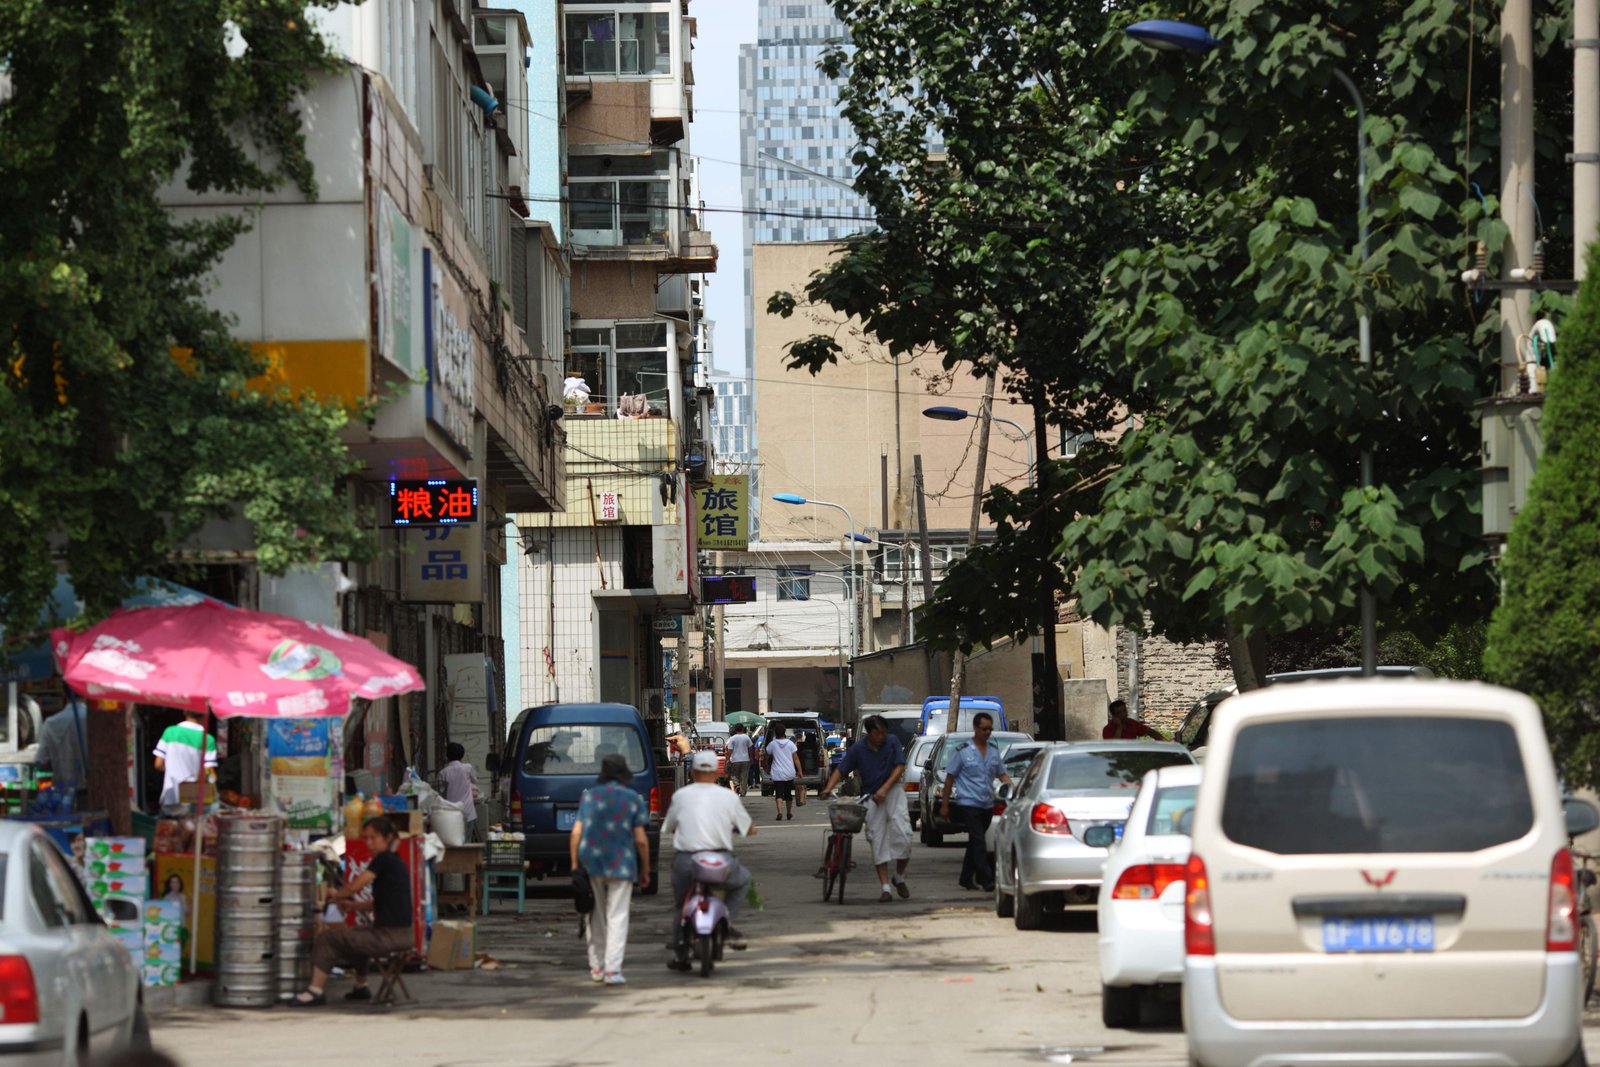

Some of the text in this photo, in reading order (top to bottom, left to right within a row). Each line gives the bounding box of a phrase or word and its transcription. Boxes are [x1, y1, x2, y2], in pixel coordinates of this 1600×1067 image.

[398, 486, 472, 519] 粮油
[603, 493, 615, 518] 旅馆
[701, 488, 739, 536] 旅馆
